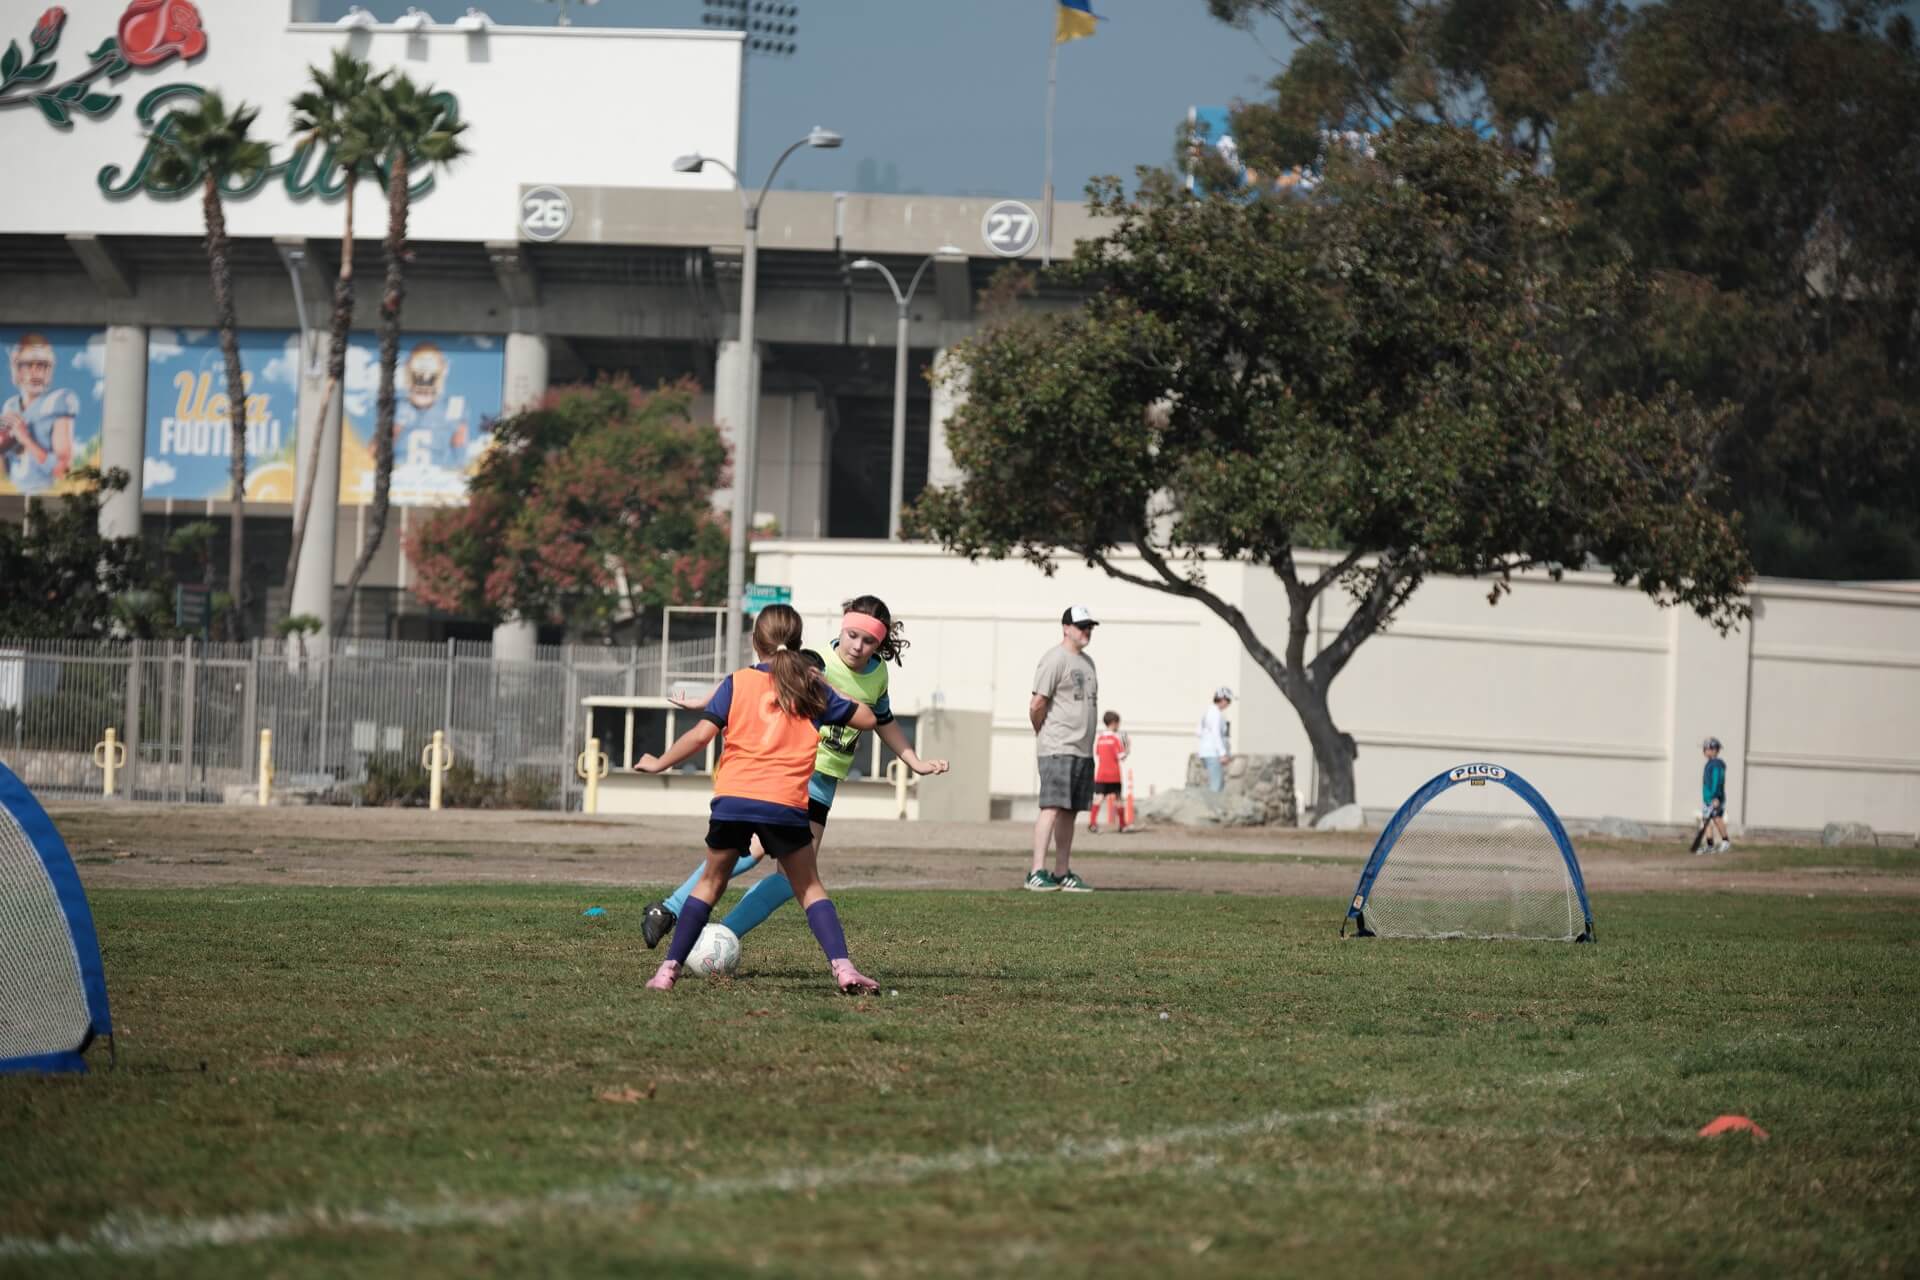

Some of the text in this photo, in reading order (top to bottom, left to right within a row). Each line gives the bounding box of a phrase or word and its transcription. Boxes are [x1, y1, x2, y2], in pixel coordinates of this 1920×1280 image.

[525, 198, 565, 228] 26
[989, 213, 1032, 243] 27
[1455, 765, 1501, 778] PUGG
